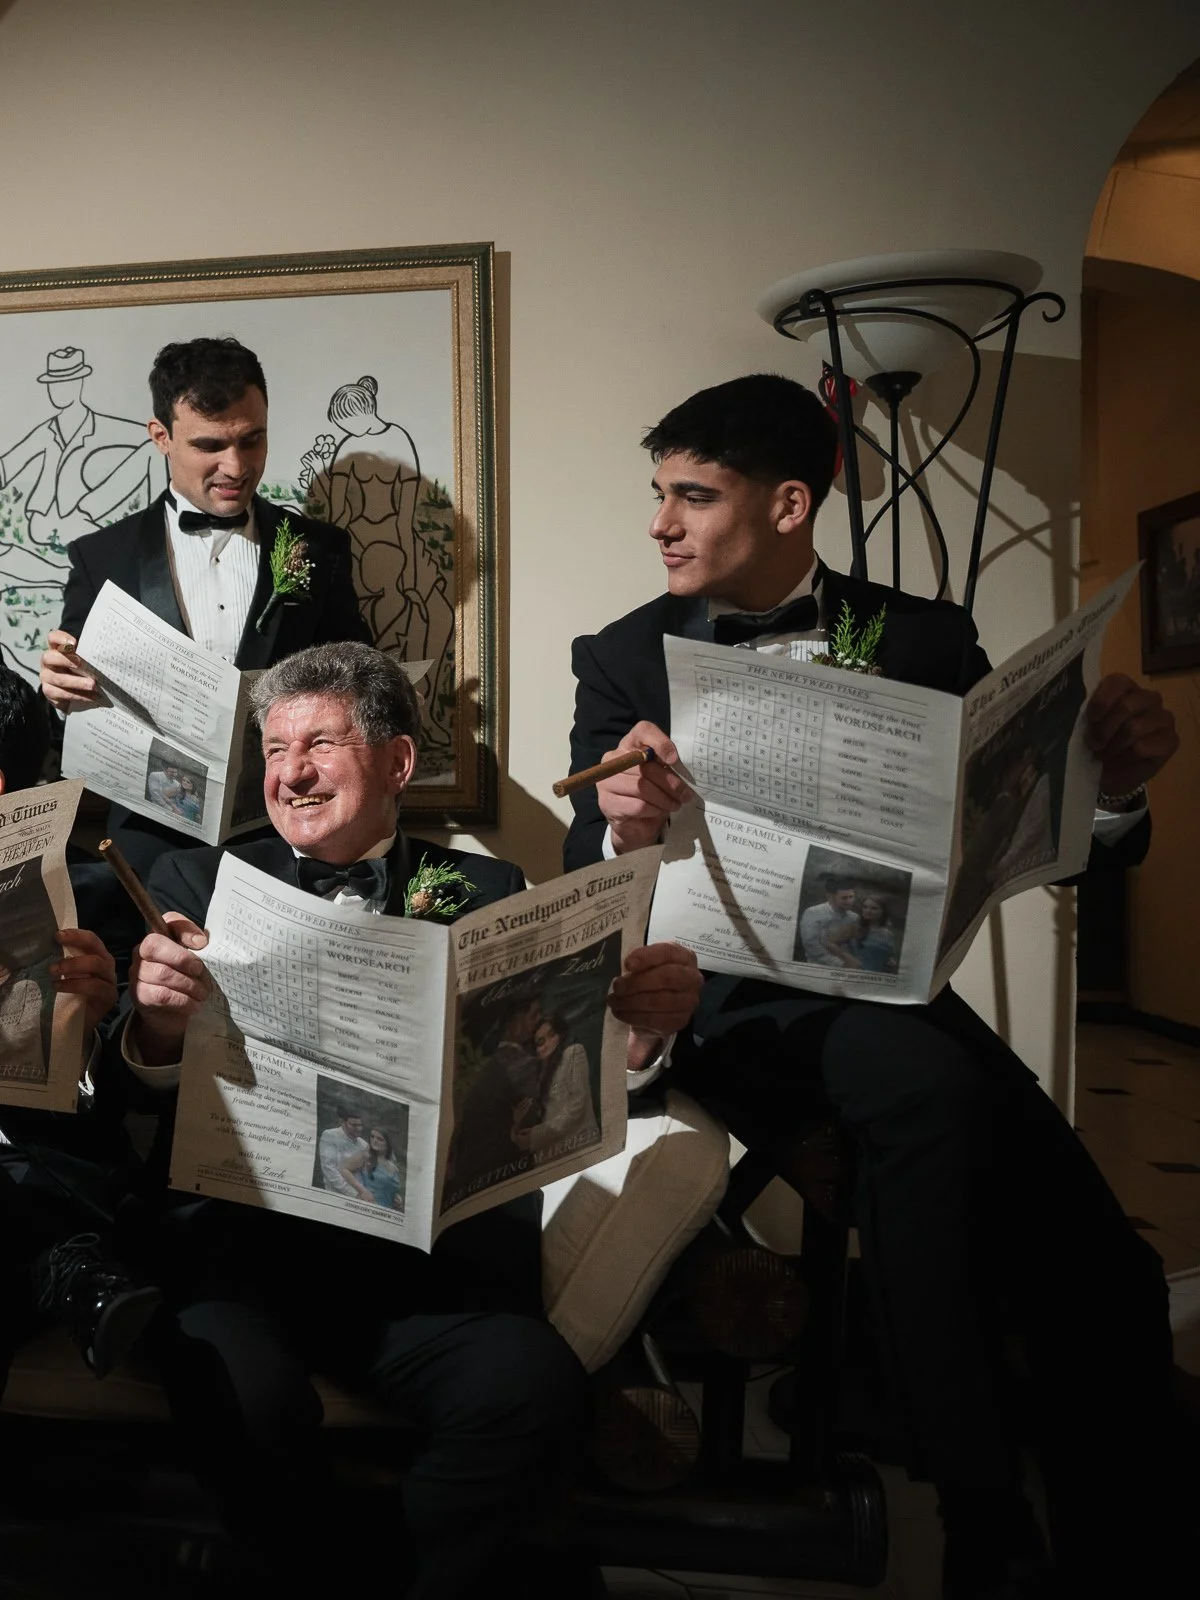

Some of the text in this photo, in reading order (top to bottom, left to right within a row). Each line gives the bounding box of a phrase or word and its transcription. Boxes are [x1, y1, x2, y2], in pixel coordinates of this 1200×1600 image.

[170, 663, 218, 692] WORDSEARCH
[746, 665, 768, 677] THE
[770, 670, 834, 690] NEWLYWED
[833, 712, 922, 743] WORDSEARCH
[12, 800, 58, 824] Times
[709, 816, 723, 825] TO
[723, 819, 744, 832] OUR
[746, 824, 783, 844] FAMILY
[785, 838, 793, 846] &
[262, 894, 275, 906] THE
[274, 901, 327, 927] NEWLYWED
[457, 928, 489, 950] The
[494, 888, 582, 934] Newlywed
[585, 870, 635, 898] Times
[326, 949, 411, 975] WORDSEARCH
[467, 957, 519, 983] MATCH
[519, 941, 562, 965] MADE
[564, 934, 580, 949] IN
[260, 1052, 295, 1071] FAMILY
[295, 1067, 304, 1075] &
